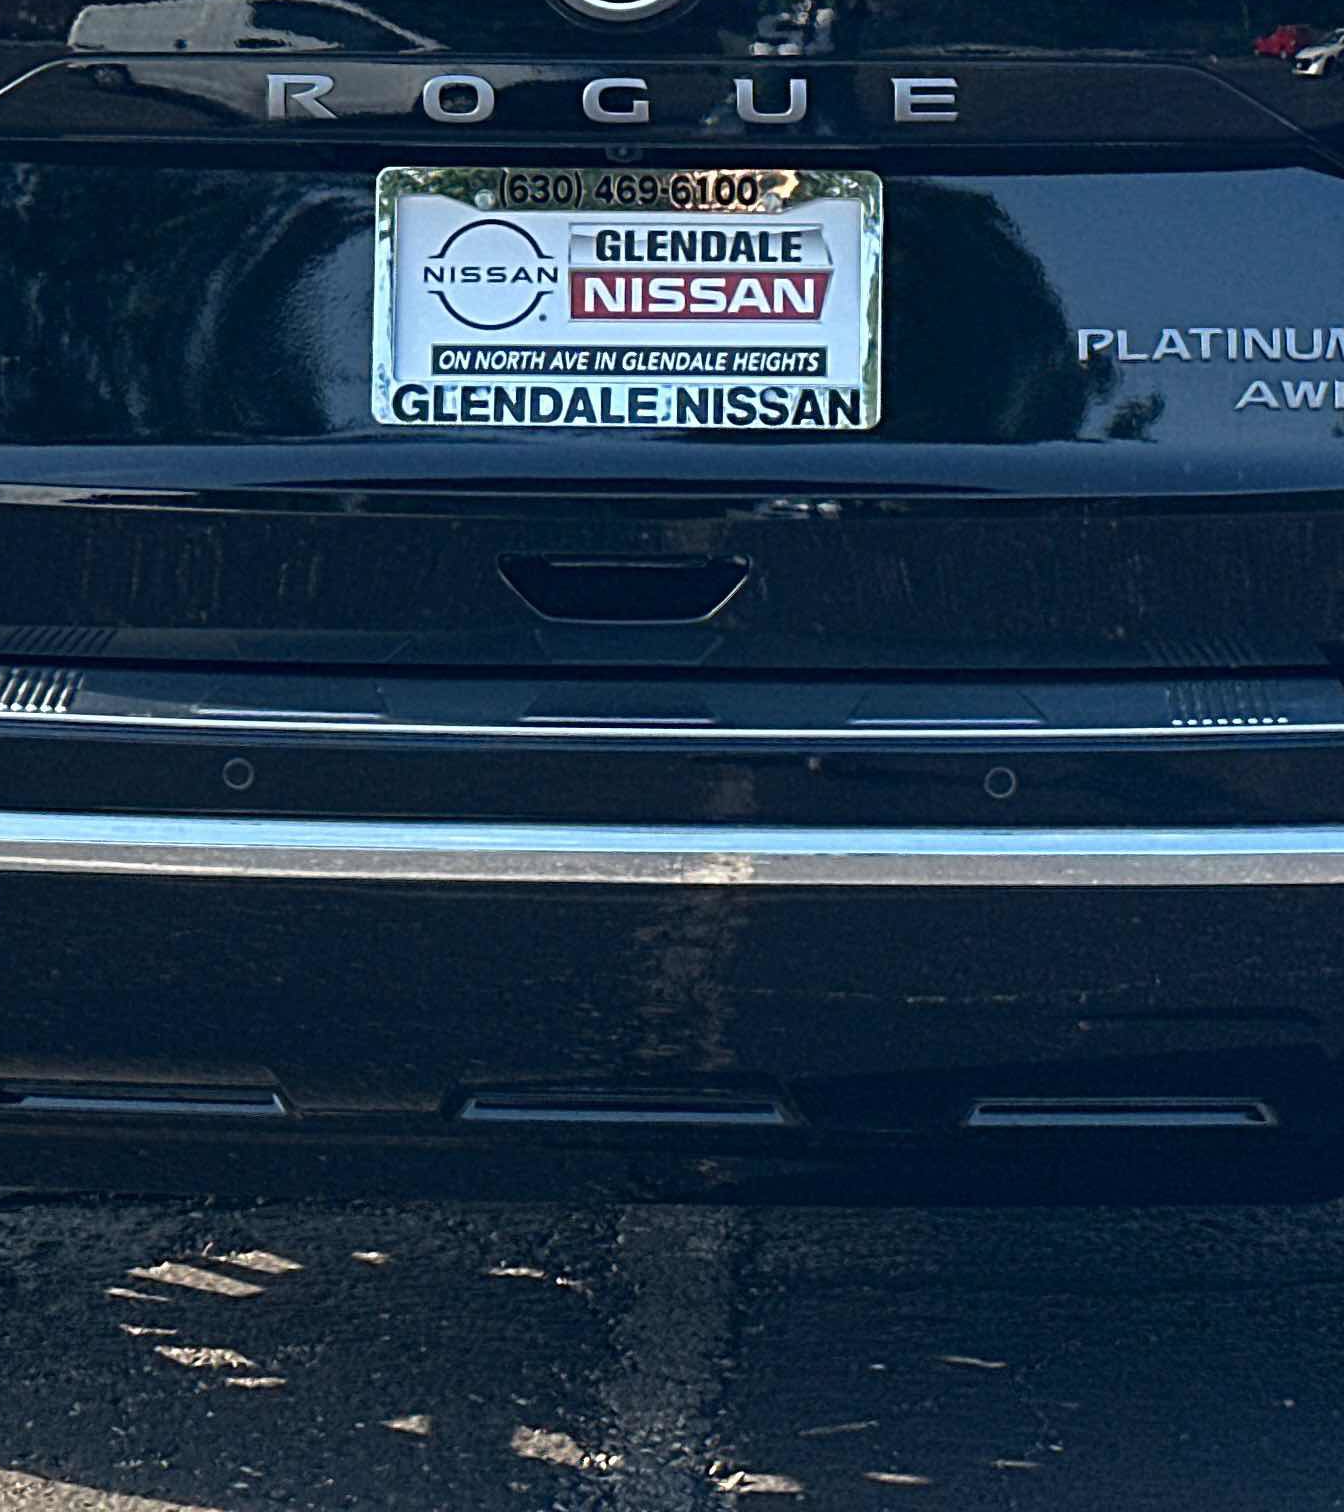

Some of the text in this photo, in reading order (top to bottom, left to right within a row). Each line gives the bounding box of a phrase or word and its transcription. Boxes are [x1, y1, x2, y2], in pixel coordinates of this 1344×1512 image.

[265, 73, 960, 124] ROGUE
[499, 169, 758, 209] (630) 469-6100
[595, 229, 803, 263] GLENDALE
[423, 266, 559, 284] NISSAN
[584, 277, 815, 313] NISSAN
[438, 350, 821, 372] ON NORTH AVE IN GLENDALE HEIGHTS
[392, 383, 861, 427] GLENDALE NISSAN
